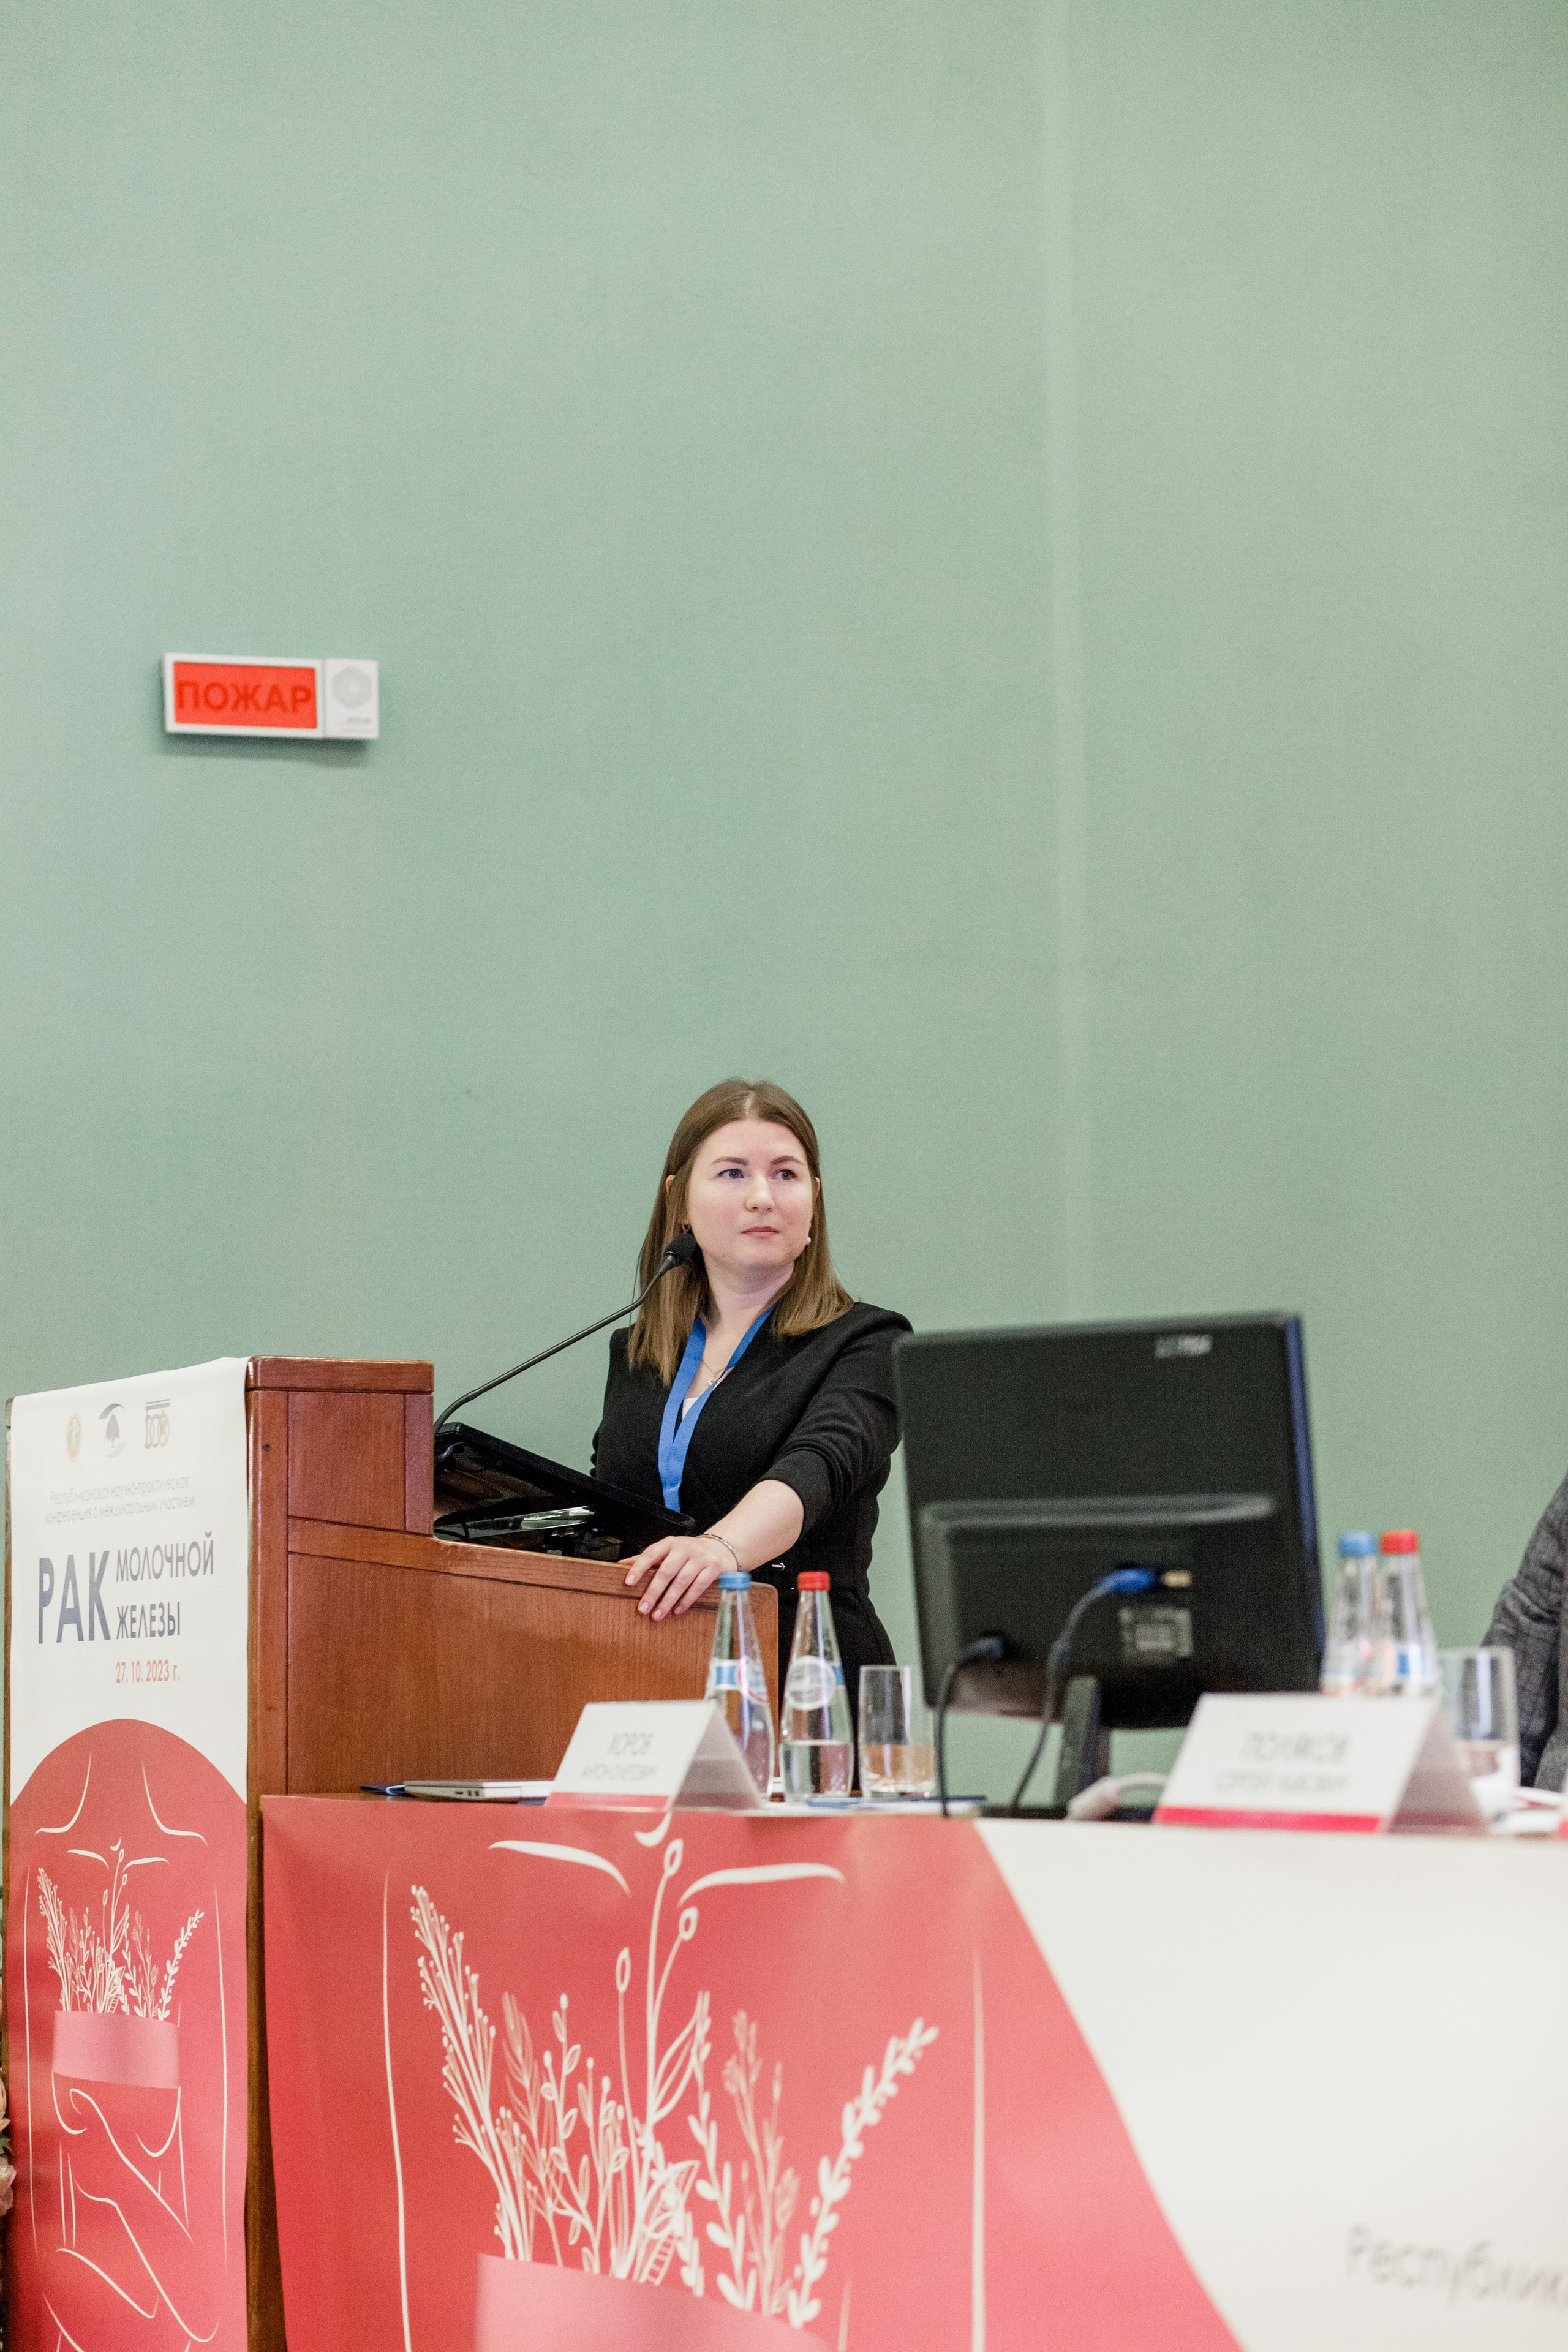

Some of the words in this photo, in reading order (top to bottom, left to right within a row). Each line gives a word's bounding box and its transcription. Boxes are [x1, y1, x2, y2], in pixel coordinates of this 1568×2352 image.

[176, 680, 313, 714] ПОЖАР
[50, 1487, 110, 1506] Республиканская
[111, 1476, 189, 1499] научно-практическая
[45, 1507, 92, 1525] конференция
[92, 1507, 98, 1518] с
[99, 1499, 157, 1518] международным
[159, 1495, 196, 1513] участием
[38, 1550, 111, 1644] РАК
[116, 1531, 214, 1582] МОЛОЧНОЙ
[116, 1601, 181, 1640] ЖЕЛЕЗЫ
[173, 1665, 181, 1681] г.
[1346, 2223, 1568, 2309] Республик
